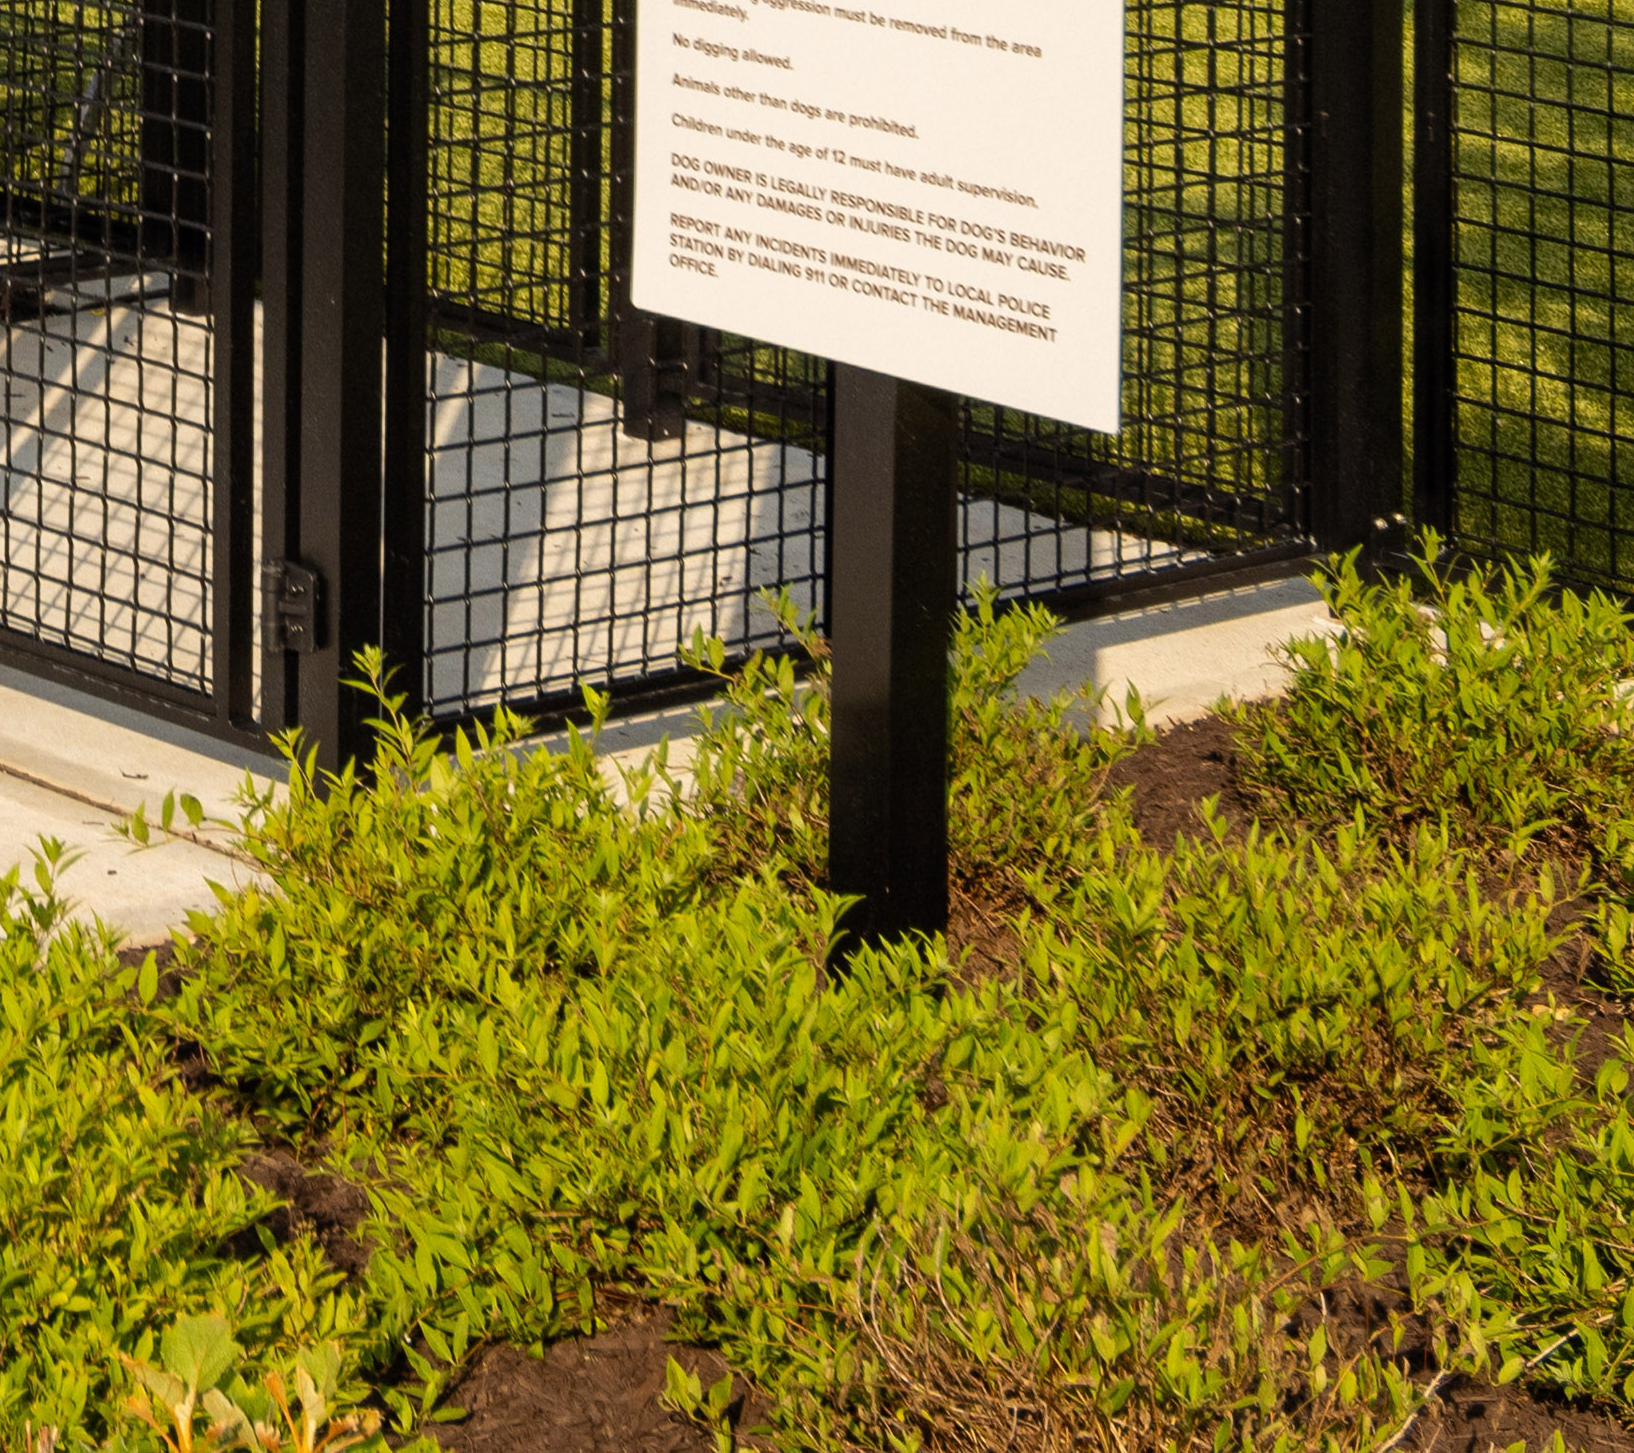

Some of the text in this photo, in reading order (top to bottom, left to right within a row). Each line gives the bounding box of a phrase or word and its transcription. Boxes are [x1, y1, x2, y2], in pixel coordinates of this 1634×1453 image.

[672, 32, 794, 71] No digging allowed.
[833, 6, 867, 24] must
[869, 11, 887, 28] be
[889, 18, 948, 40] removed
[950, 26, 983, 46] from
[984, 34, 1009, 52] the
[1011, 42, 1043, 59] area
[671, 72, 920, 140] Animals other than dogs are prohibited.
[671, 112, 1039, 209] Children under the age of 12 must have adult supervision.
[671, 152, 701, 172] DOG
[702, 160, 753, 185] OWNER
[755, 172, 768, 188] IS
[770, 176, 828, 202] LEGALLY
[830, 189, 925, 226] RESPONSIBLE
[927, 212, 958, 233] FOR
[1009, 231, 1086, 264] BEHAVIOR
[668, 252, 719, 278] OFFICE.
[669, 212, 1051, 320] REPORT ANY INCIDENTS IMMEDIATELY TO LOCAL POLICE
[670, 172, 1071, 282] AND/OR ANY DAMAGES OR INJURIES THE DOG MAY CAUSE.
[669, 232, 1058, 343] STATION BY DIALING 911 OR CONTACT THE MANAGEMENT
